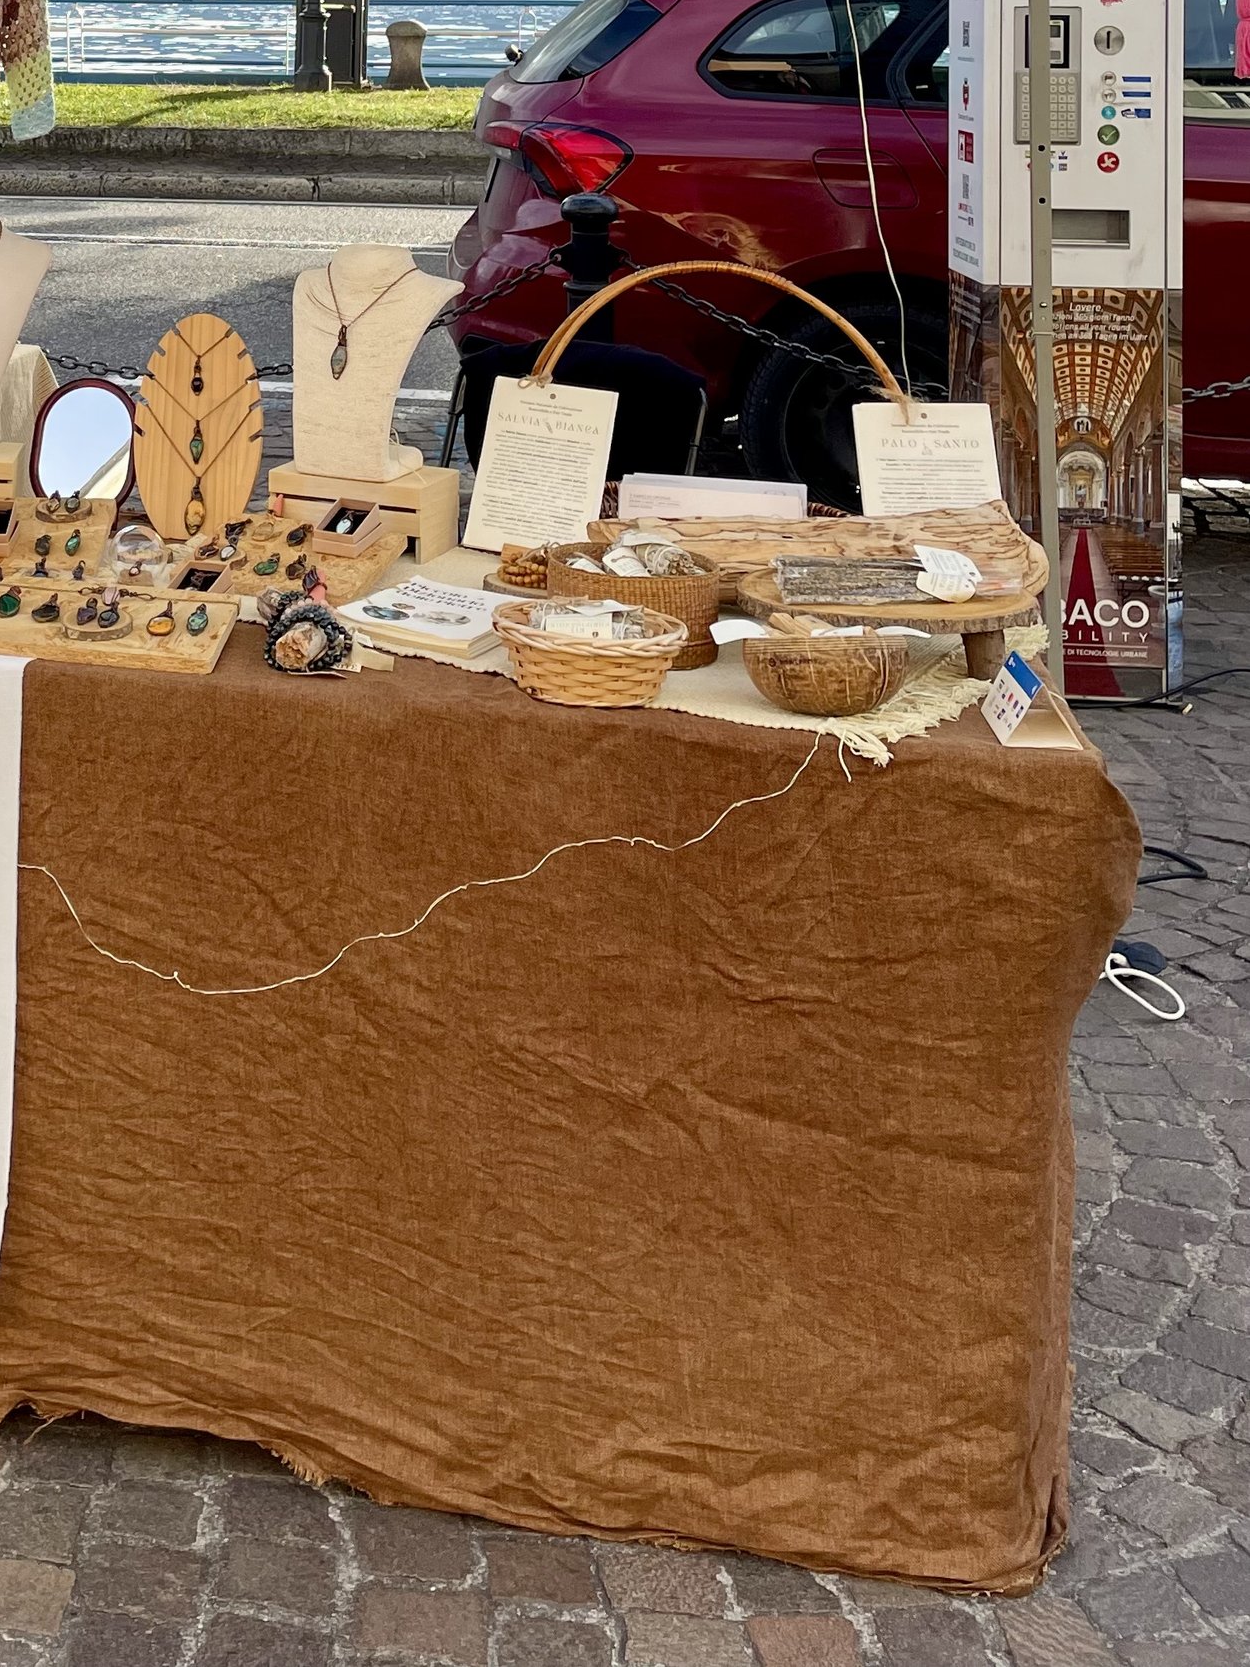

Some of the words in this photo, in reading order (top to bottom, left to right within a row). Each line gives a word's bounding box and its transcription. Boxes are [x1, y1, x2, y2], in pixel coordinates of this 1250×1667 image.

[881, 438, 917, 448] PALO
[934, 439, 980, 449] SANTO
[1061, 599, 1149, 628] ACO
[1062, 629, 1148, 643] BILITY
